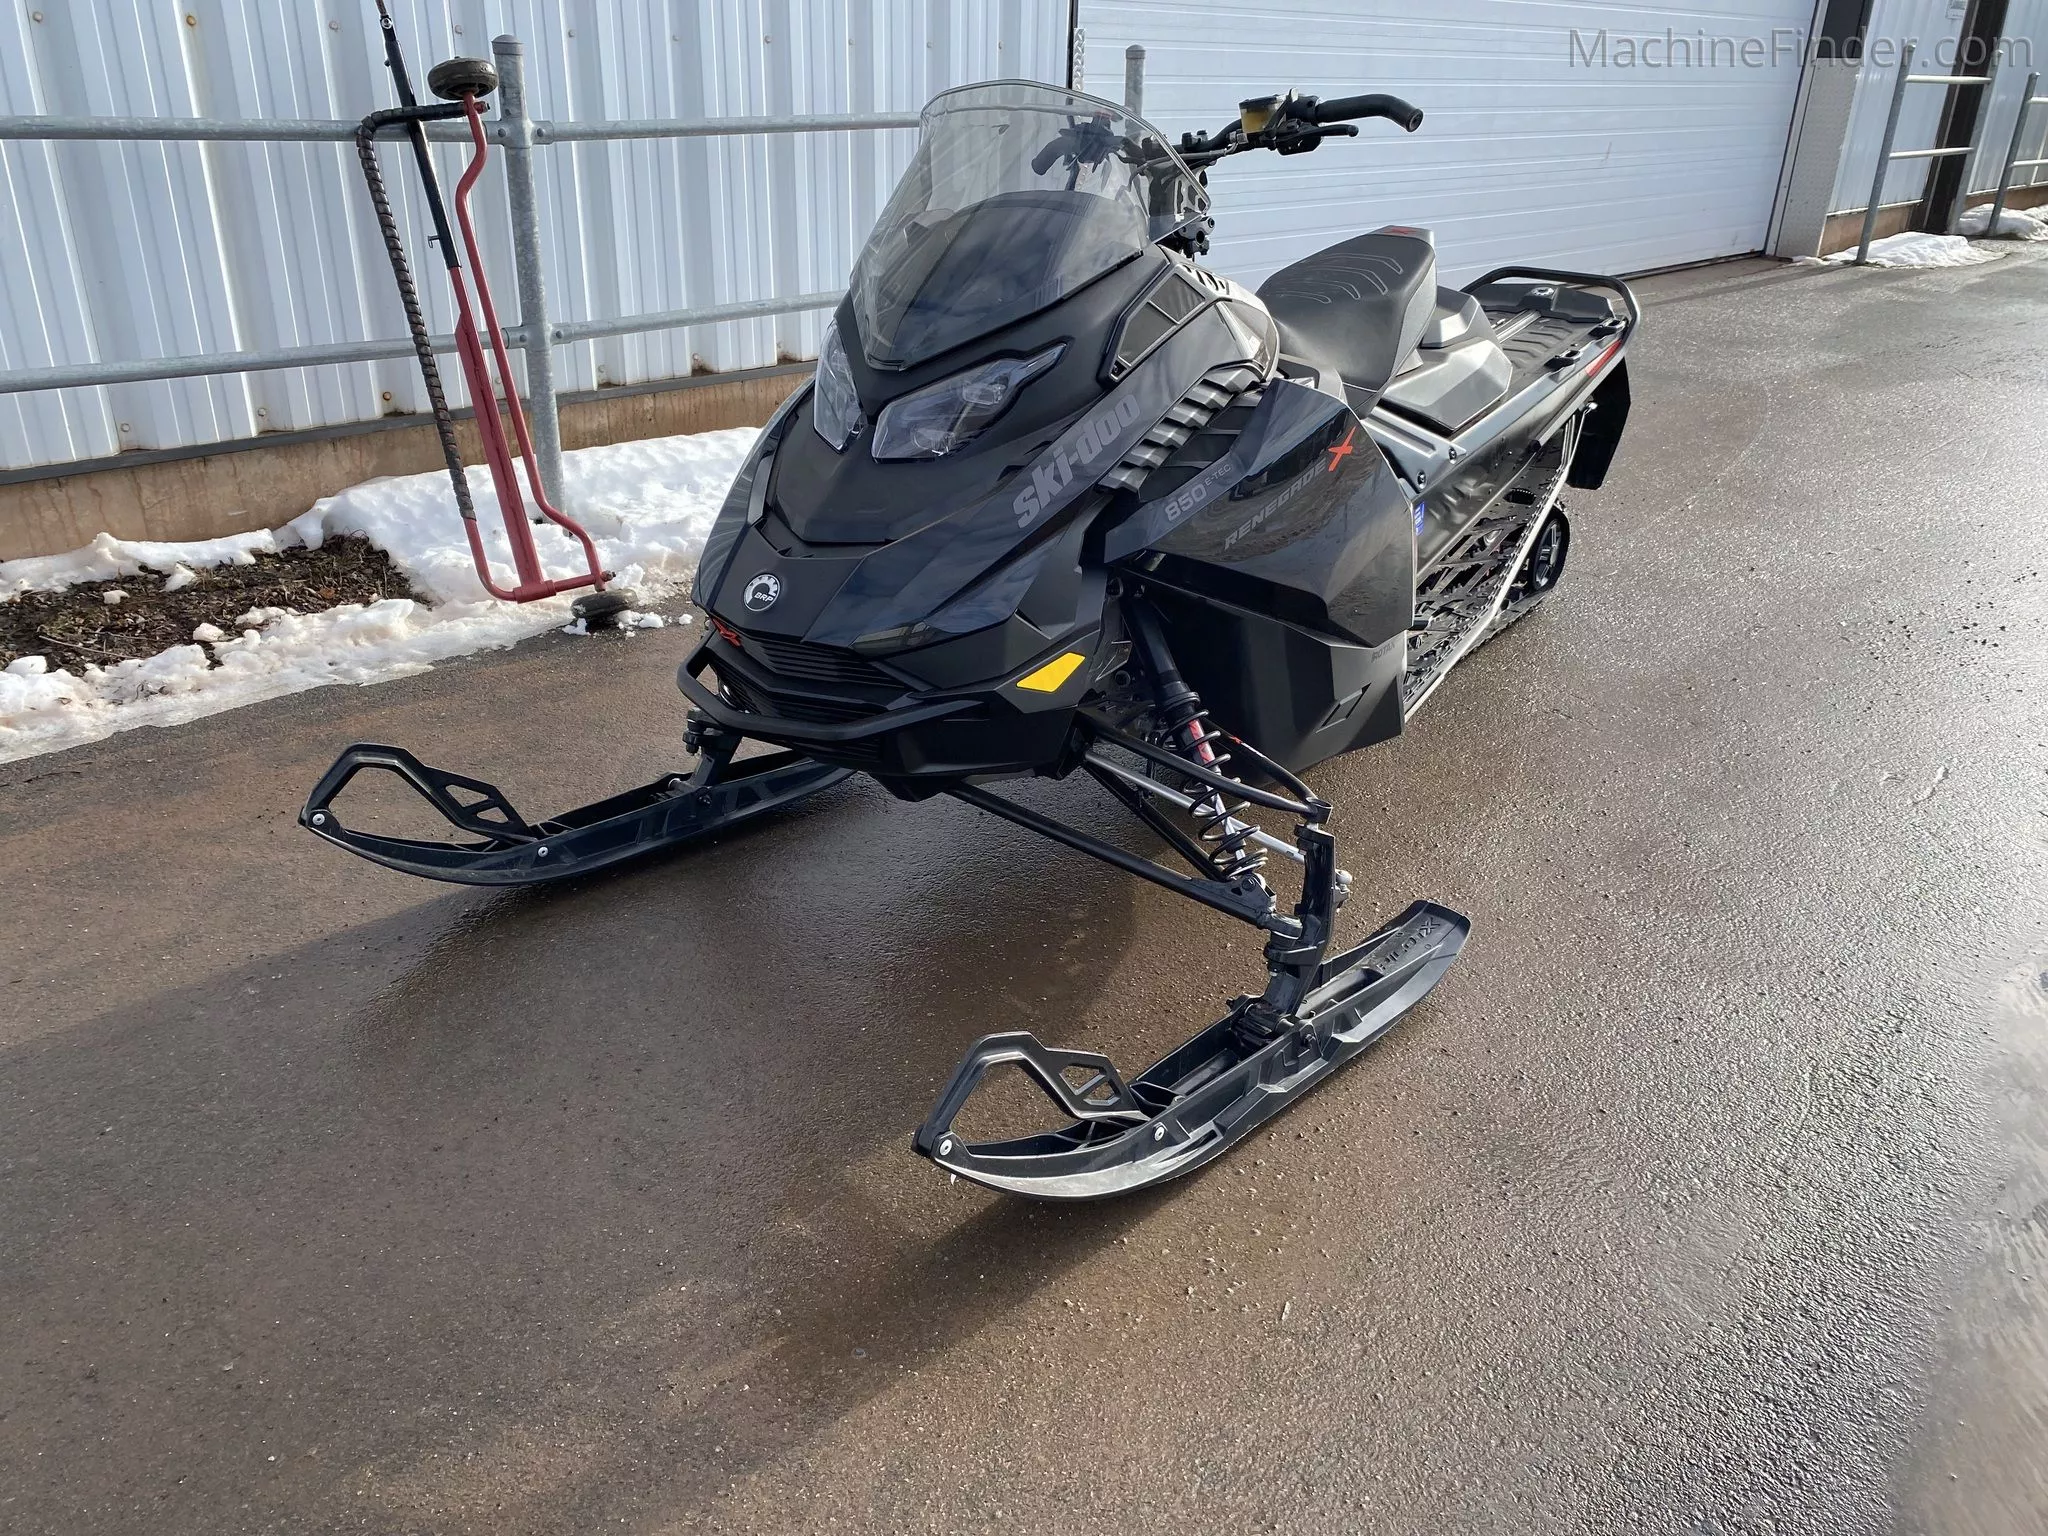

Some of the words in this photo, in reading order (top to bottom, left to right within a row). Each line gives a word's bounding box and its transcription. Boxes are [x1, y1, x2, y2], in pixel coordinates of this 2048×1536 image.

[1164, 482, 1208, 522] 850
[1204, 464, 1232, 487] E-TEC
[1224, 458, 1327, 550] RENEGADE
[753, 591, 774, 602] BRP
